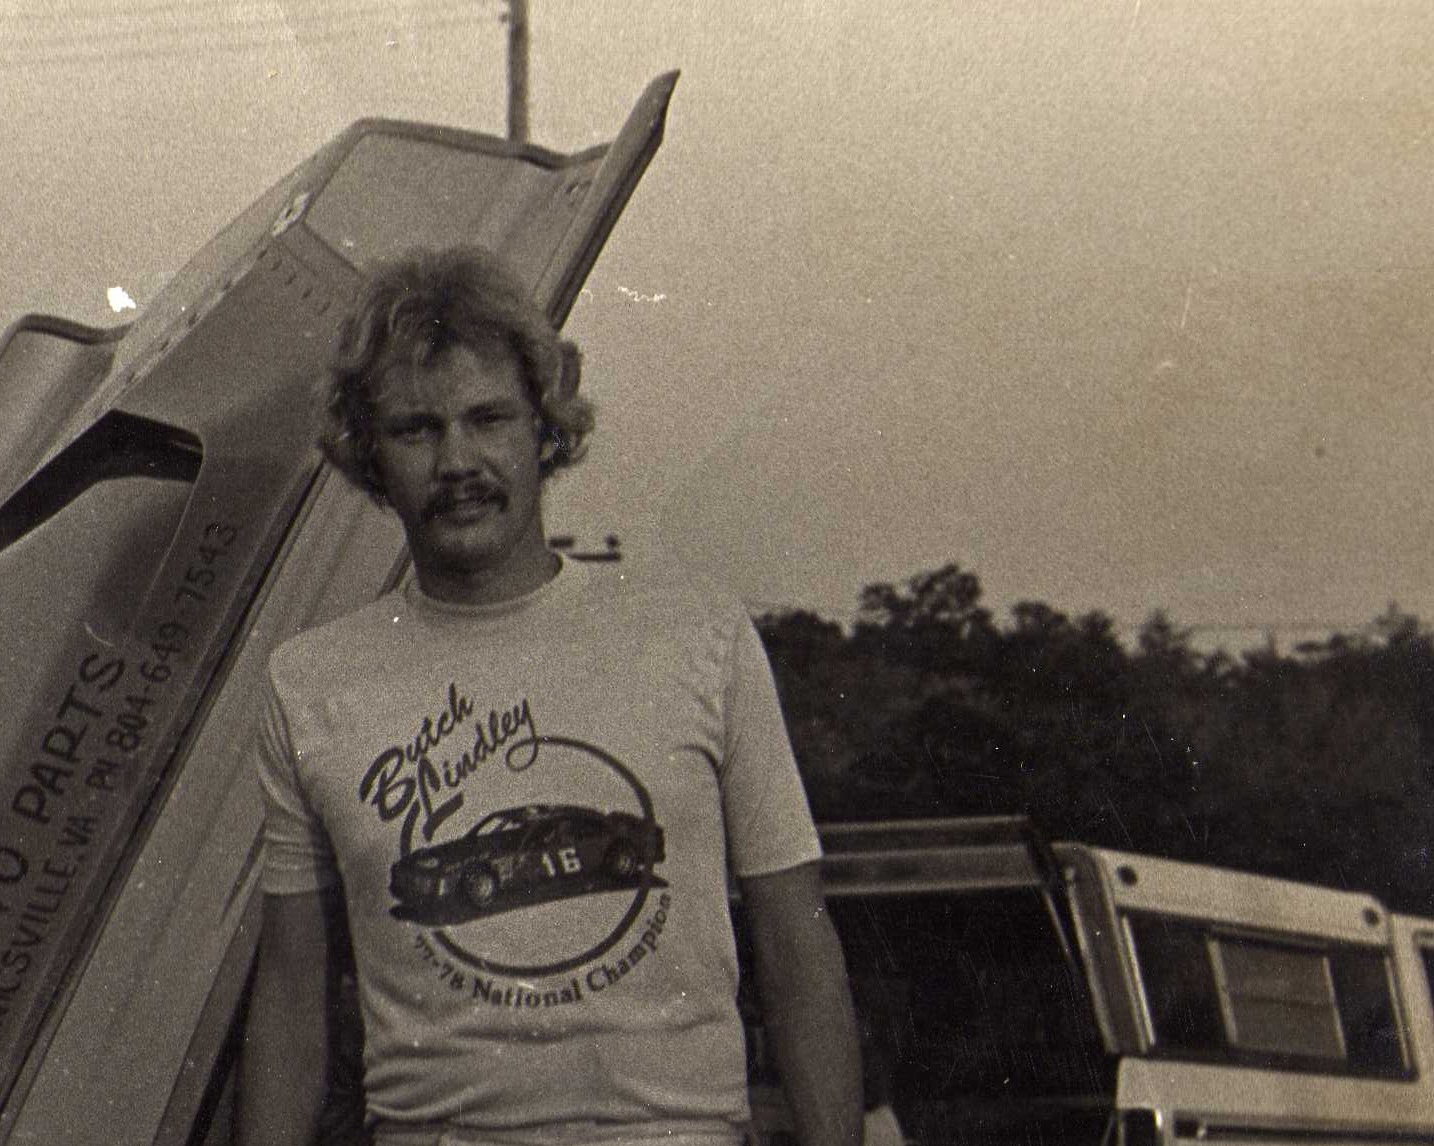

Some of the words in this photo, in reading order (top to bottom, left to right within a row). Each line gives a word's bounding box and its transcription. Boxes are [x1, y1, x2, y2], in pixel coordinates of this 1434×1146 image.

[108, 523, 236, 752] 804-649-7543
[13, 652, 126, 825] PARTS
[359, 682, 474, 822] Butch
[418, 698, 538, 841] Lindley
[541, 848, 581, 878] 16
[472, 978, 583, 1009] National
[586, 893, 672, 993] Champion
